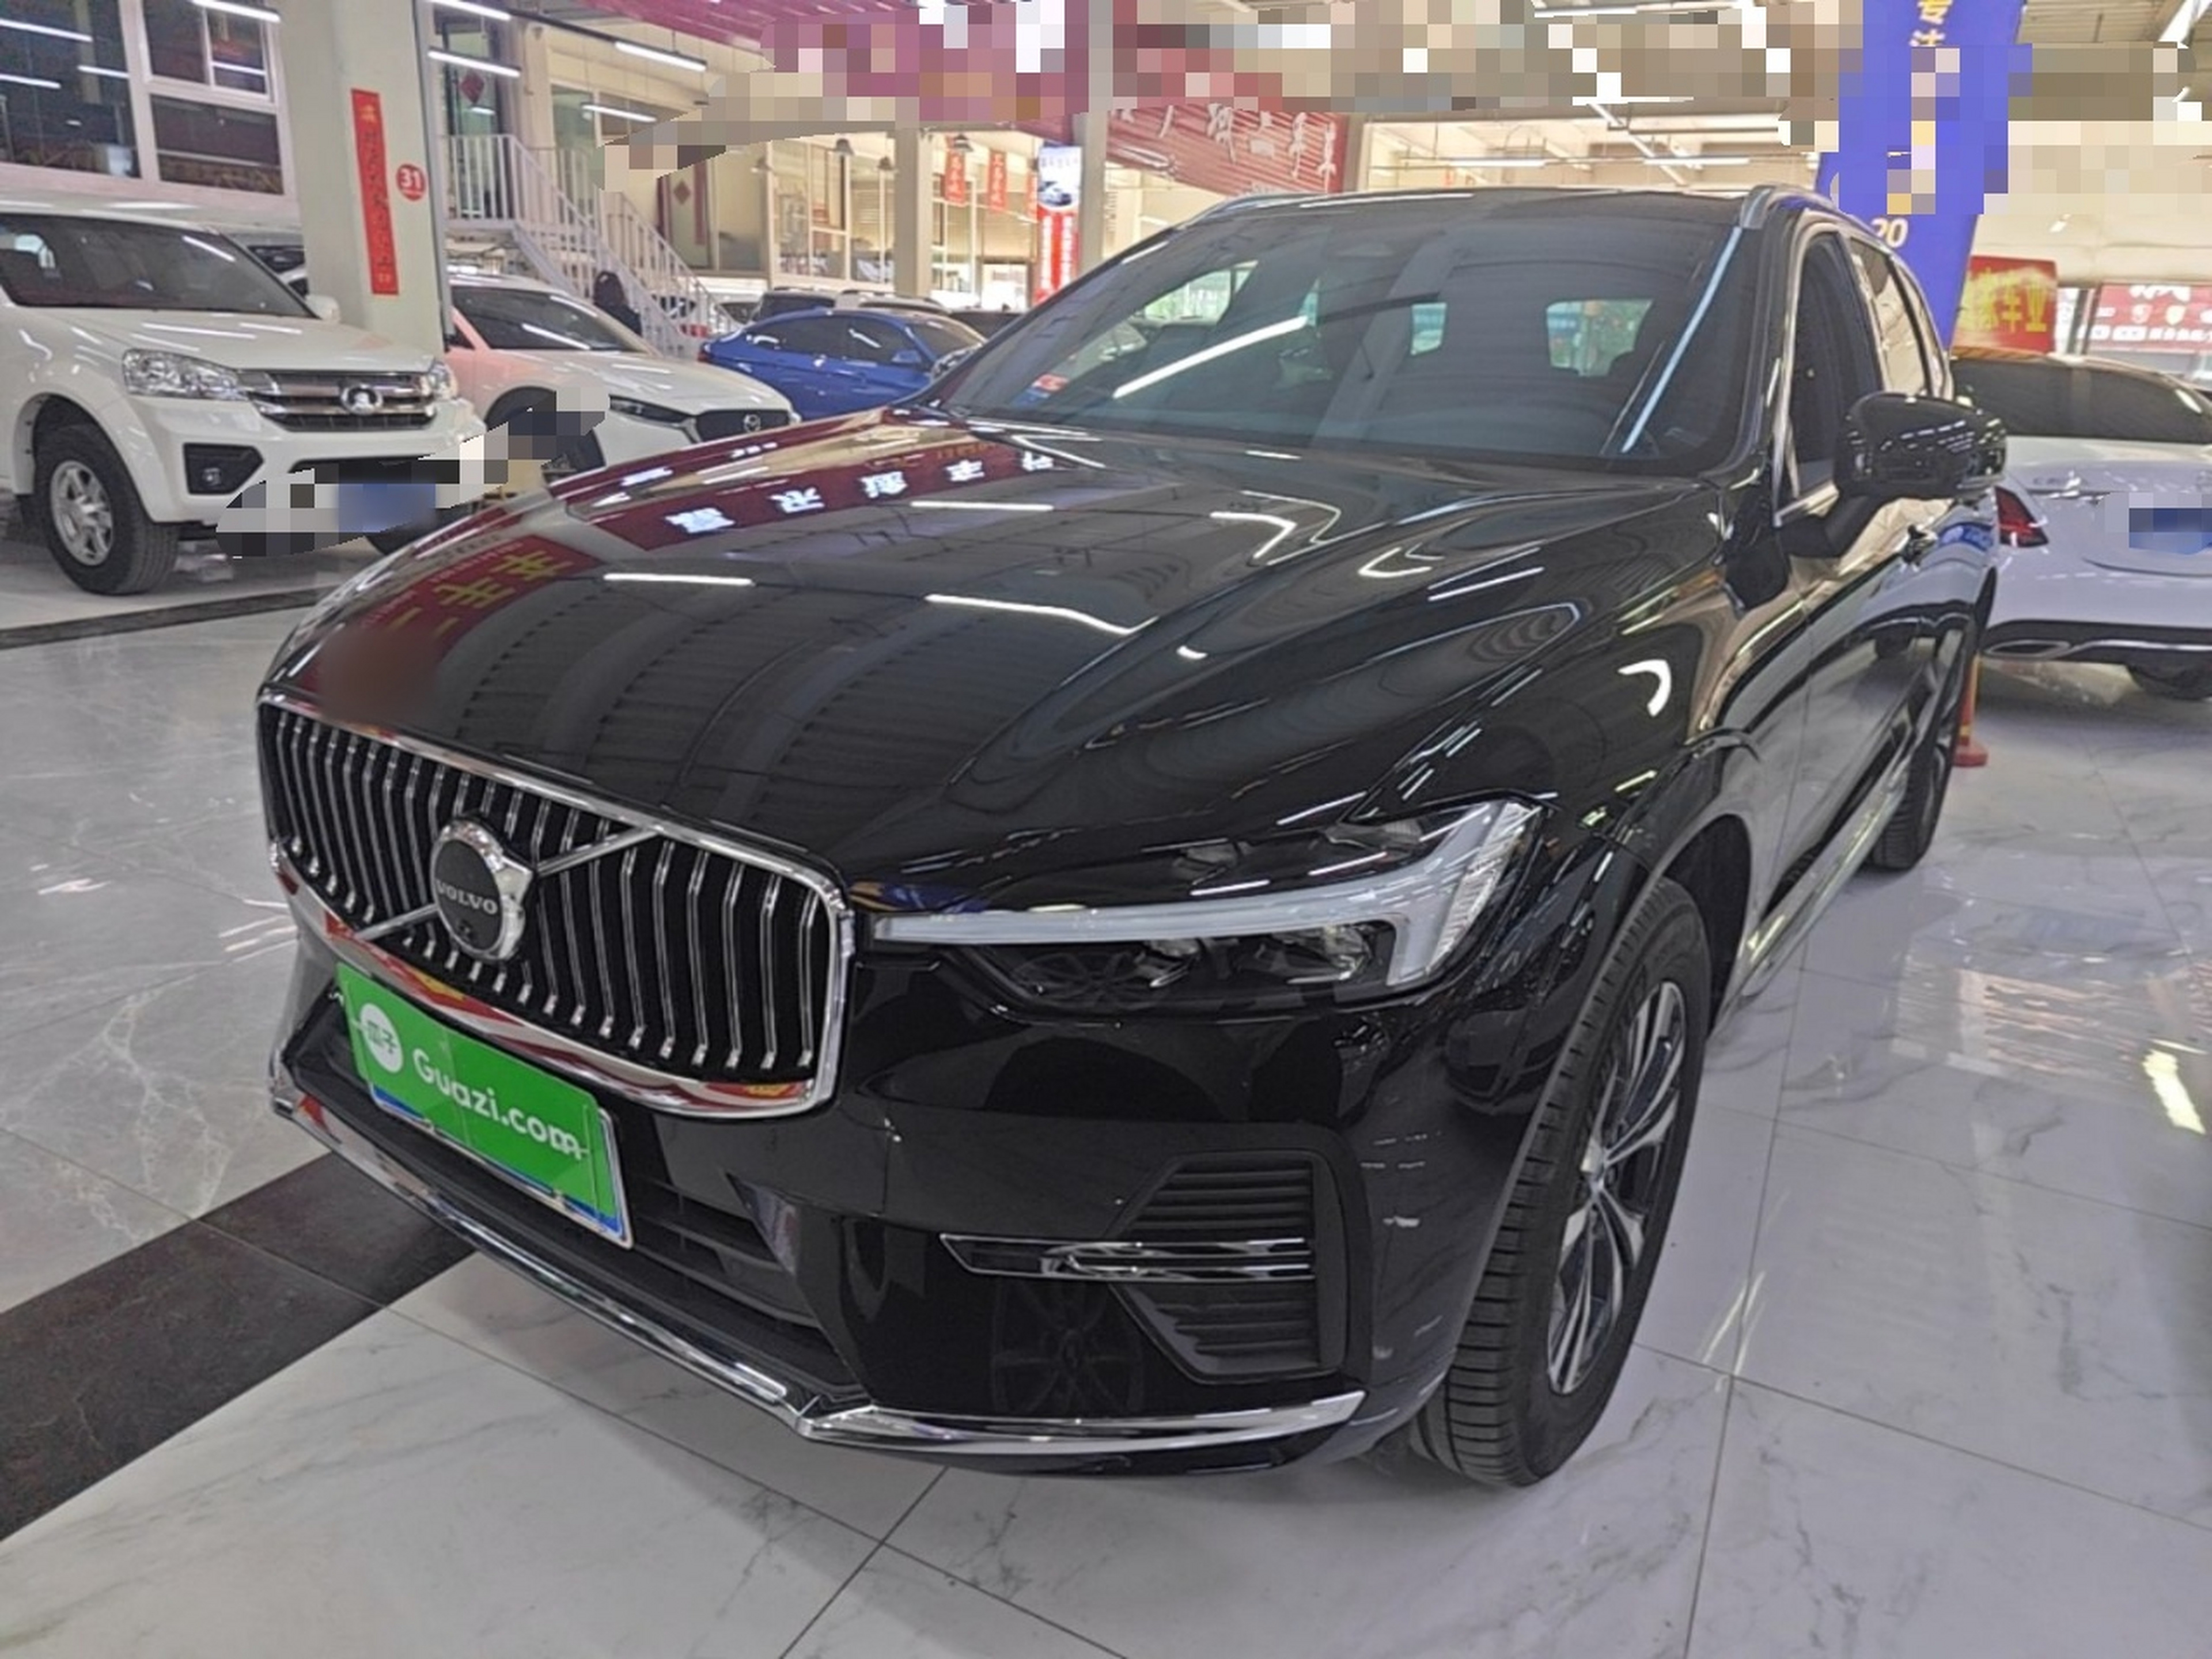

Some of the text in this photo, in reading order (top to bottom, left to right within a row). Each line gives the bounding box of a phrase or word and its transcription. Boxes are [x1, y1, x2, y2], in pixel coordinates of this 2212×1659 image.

[400, 167, 422, 188] 31
[435, 878, 498, 915] VOLVO
[413, 1048, 582, 1161] Guazi.com
